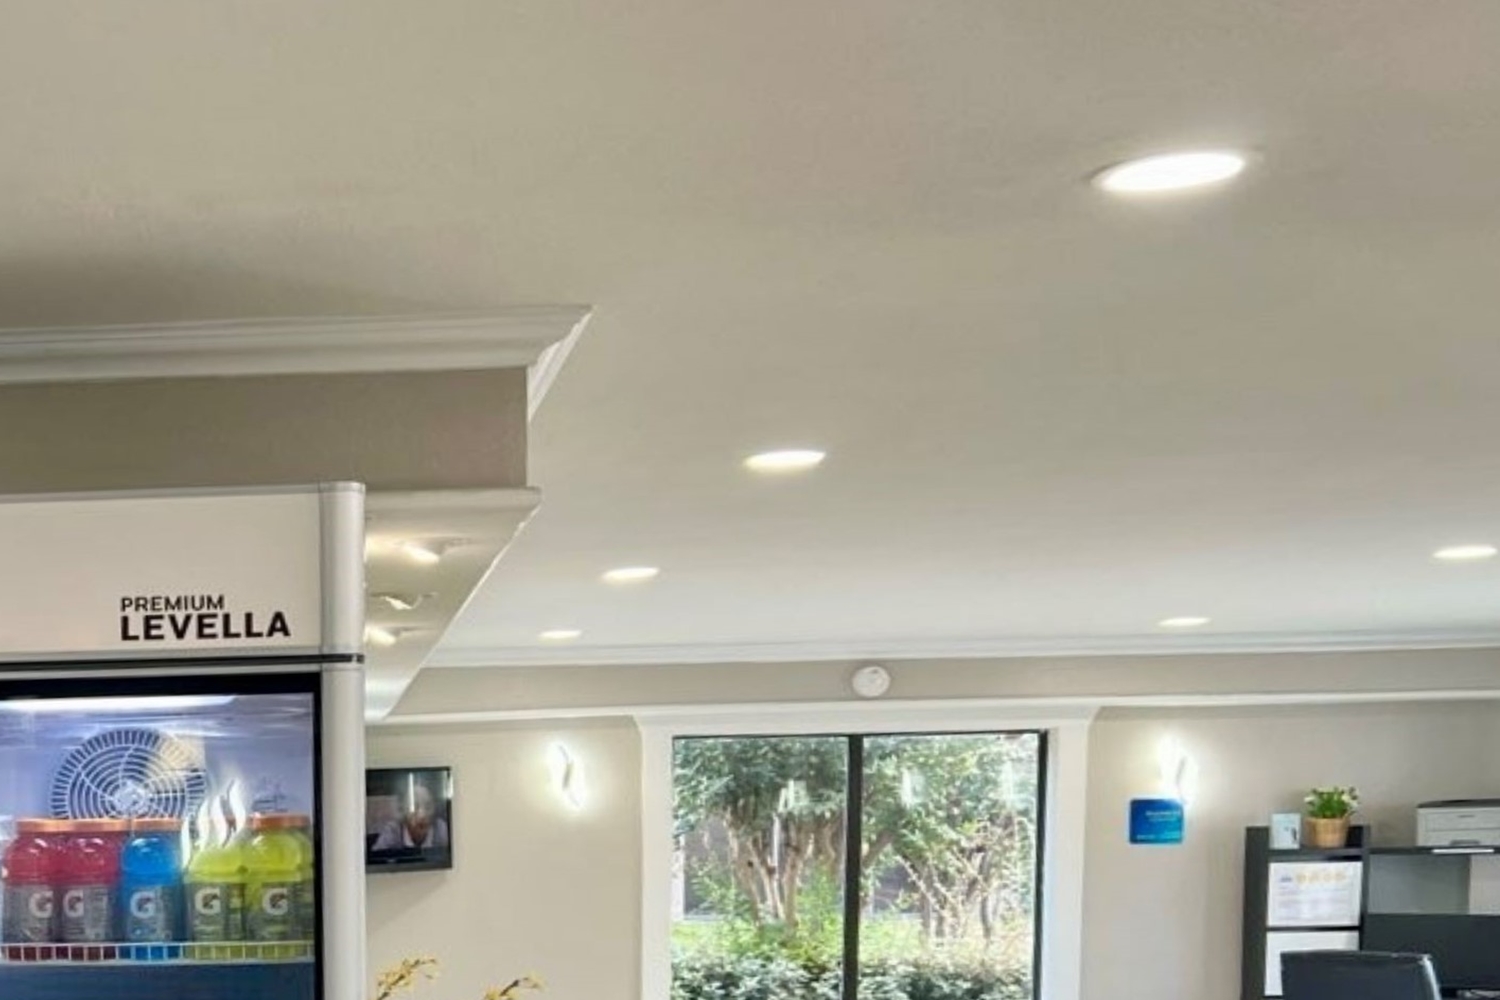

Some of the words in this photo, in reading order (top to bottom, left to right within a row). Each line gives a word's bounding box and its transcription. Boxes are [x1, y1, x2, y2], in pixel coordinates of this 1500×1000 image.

[120, 594, 225, 612] PREMIUM
[120, 611, 291, 641] LEVELLA
[28, 891, 54, 919] G
[63, 890, 85, 918] G
[130, 891, 156, 919] G
[195, 887, 222, 915] G
[262, 887, 289, 916] G
